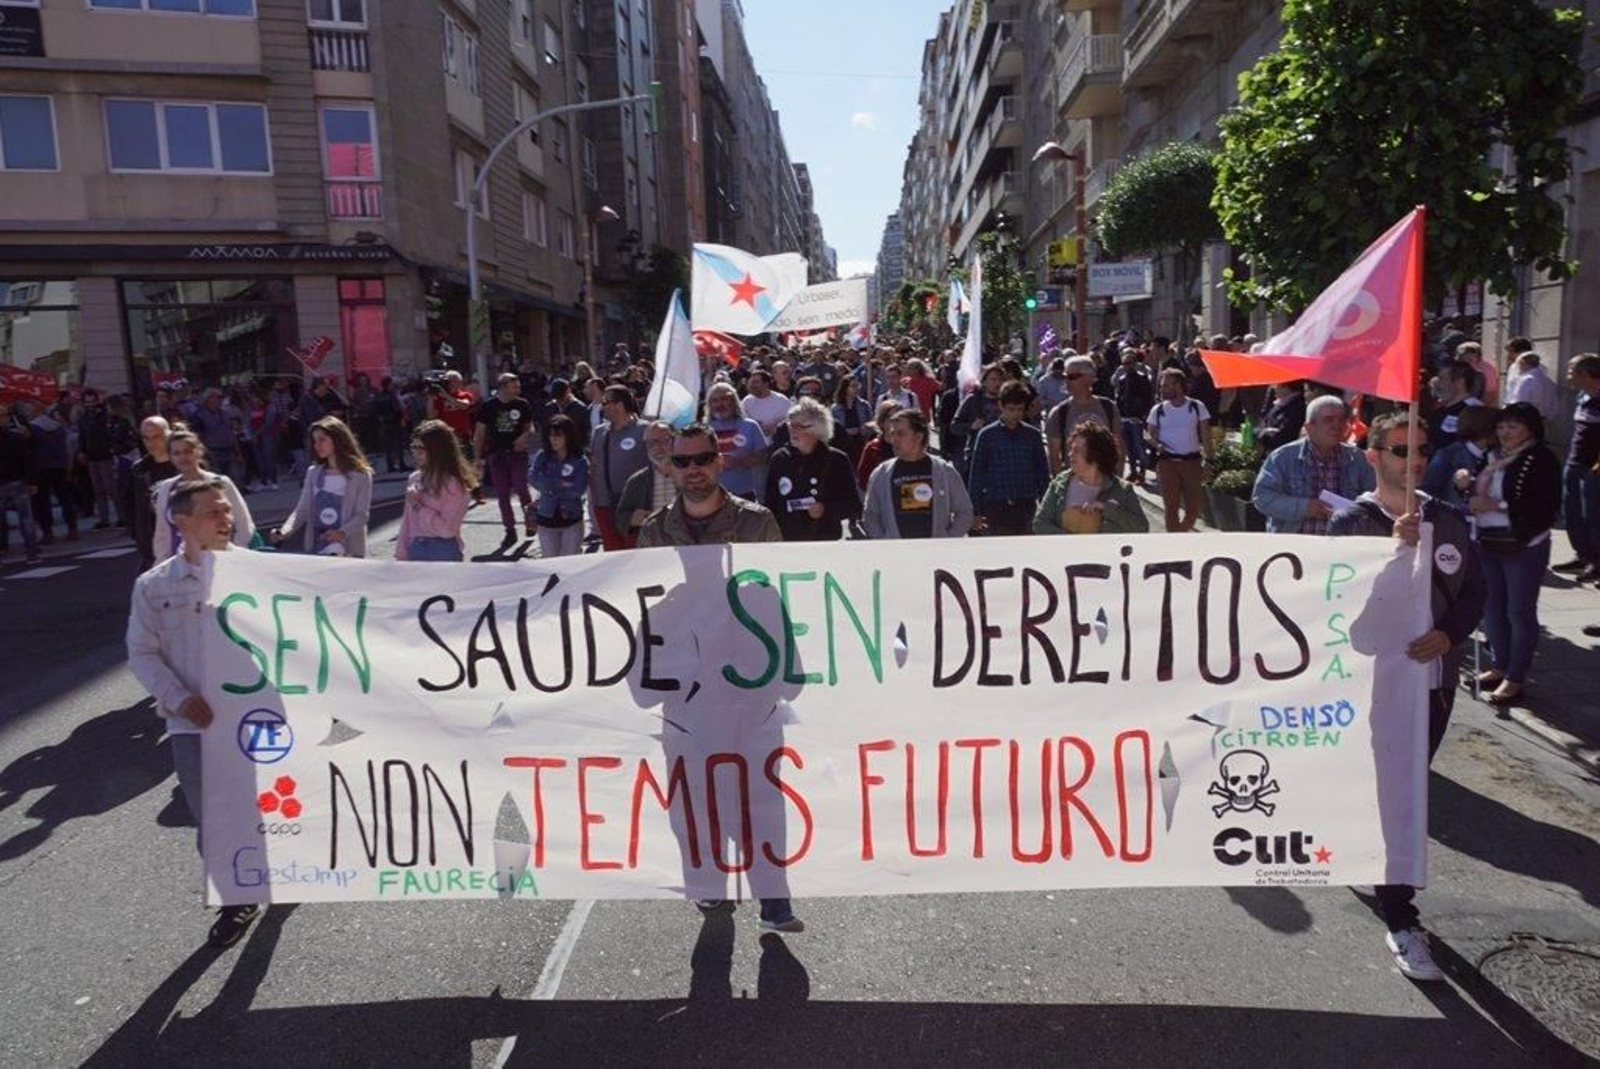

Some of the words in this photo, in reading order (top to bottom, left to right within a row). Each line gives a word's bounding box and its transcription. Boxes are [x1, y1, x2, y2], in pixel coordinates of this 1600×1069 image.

[215, 593, 371, 695] SEN
[416, 572, 701, 703] SAÚDE,
[722, 569, 884, 690] SEN
[232, 846, 357, 888] Gestamp
[329, 758, 475, 870] NON
[503, 746, 814, 873] TEMOS
[858, 729, 1152, 863] FUTURO
